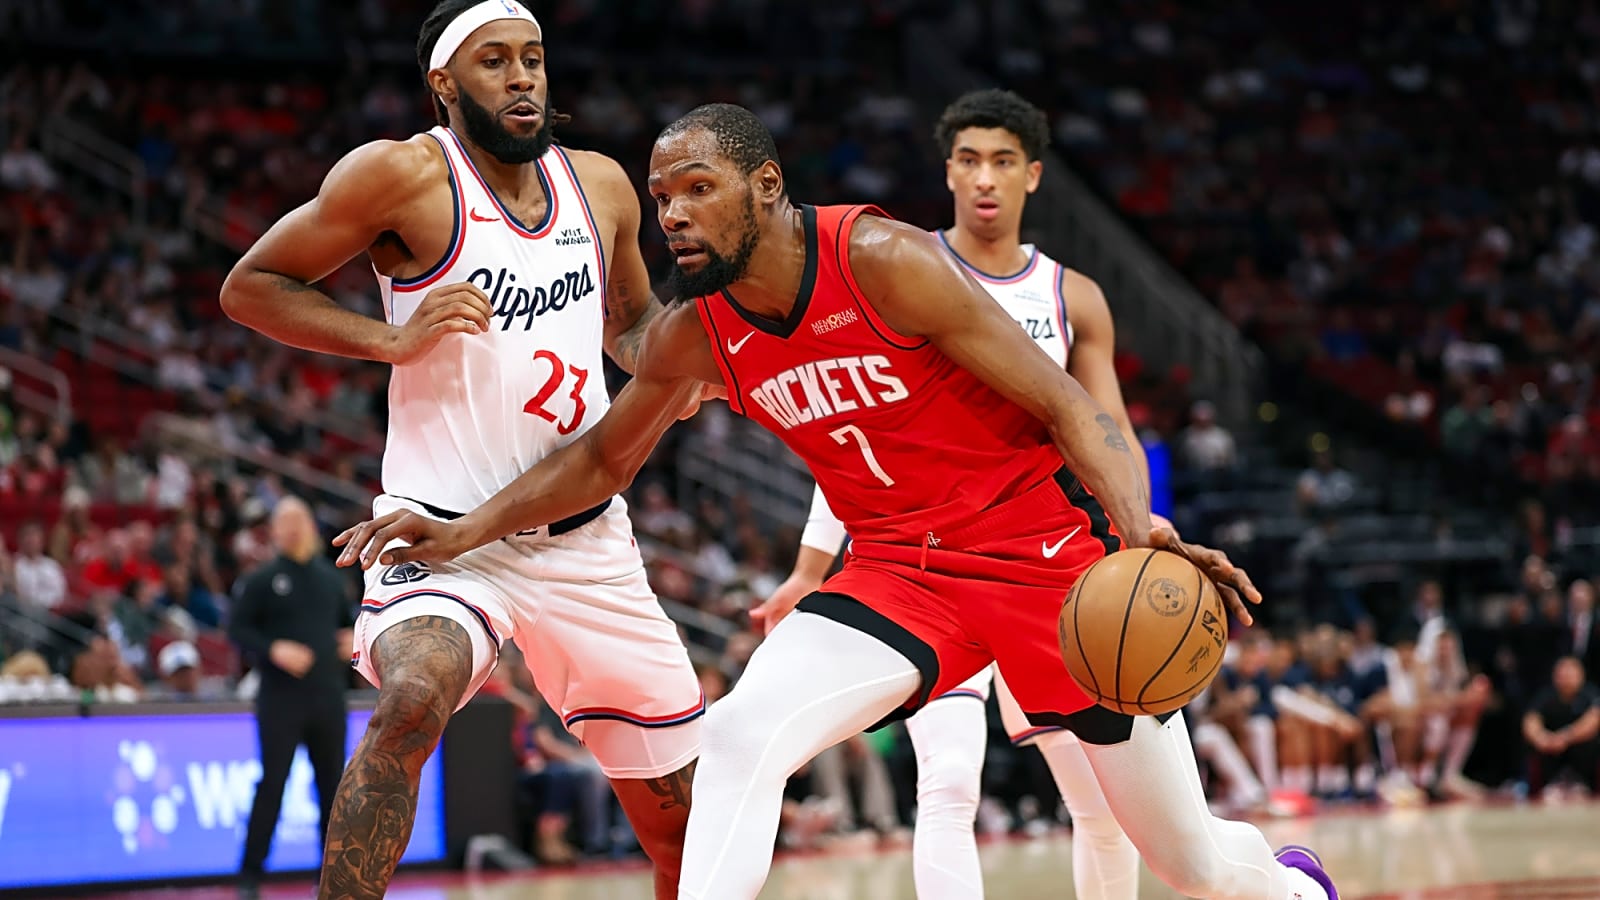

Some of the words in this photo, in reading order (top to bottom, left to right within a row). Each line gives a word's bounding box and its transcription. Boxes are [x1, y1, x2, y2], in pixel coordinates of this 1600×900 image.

[555, 236, 591, 246] RWANDA
[466, 262, 595, 332] Clippers
[811, 307, 854, 330] MEMORIAL
[813, 311, 858, 336] HERMANN
[523, 350, 588, 435] 23
[750, 354, 910, 430] ROCKETS
[828, 424, 895, 487] 7
